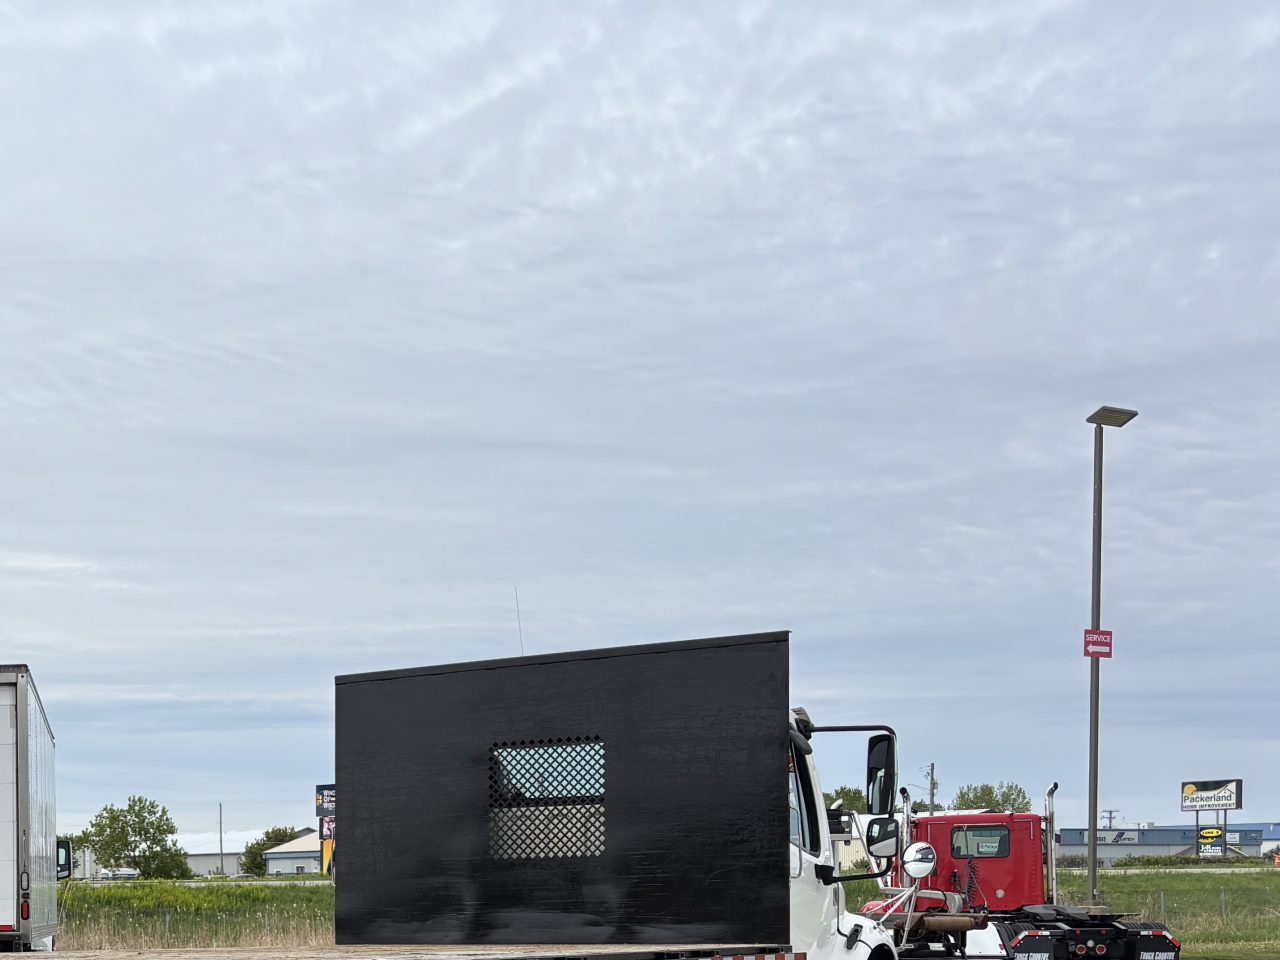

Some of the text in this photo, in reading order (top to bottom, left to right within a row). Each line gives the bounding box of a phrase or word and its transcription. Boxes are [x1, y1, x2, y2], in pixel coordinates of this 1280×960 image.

[1085, 634, 1111, 642] SERVICE
[1183, 793, 1232, 803] Packerland
[1140, 951, 1176, 960] TRUCK COUNTRY
